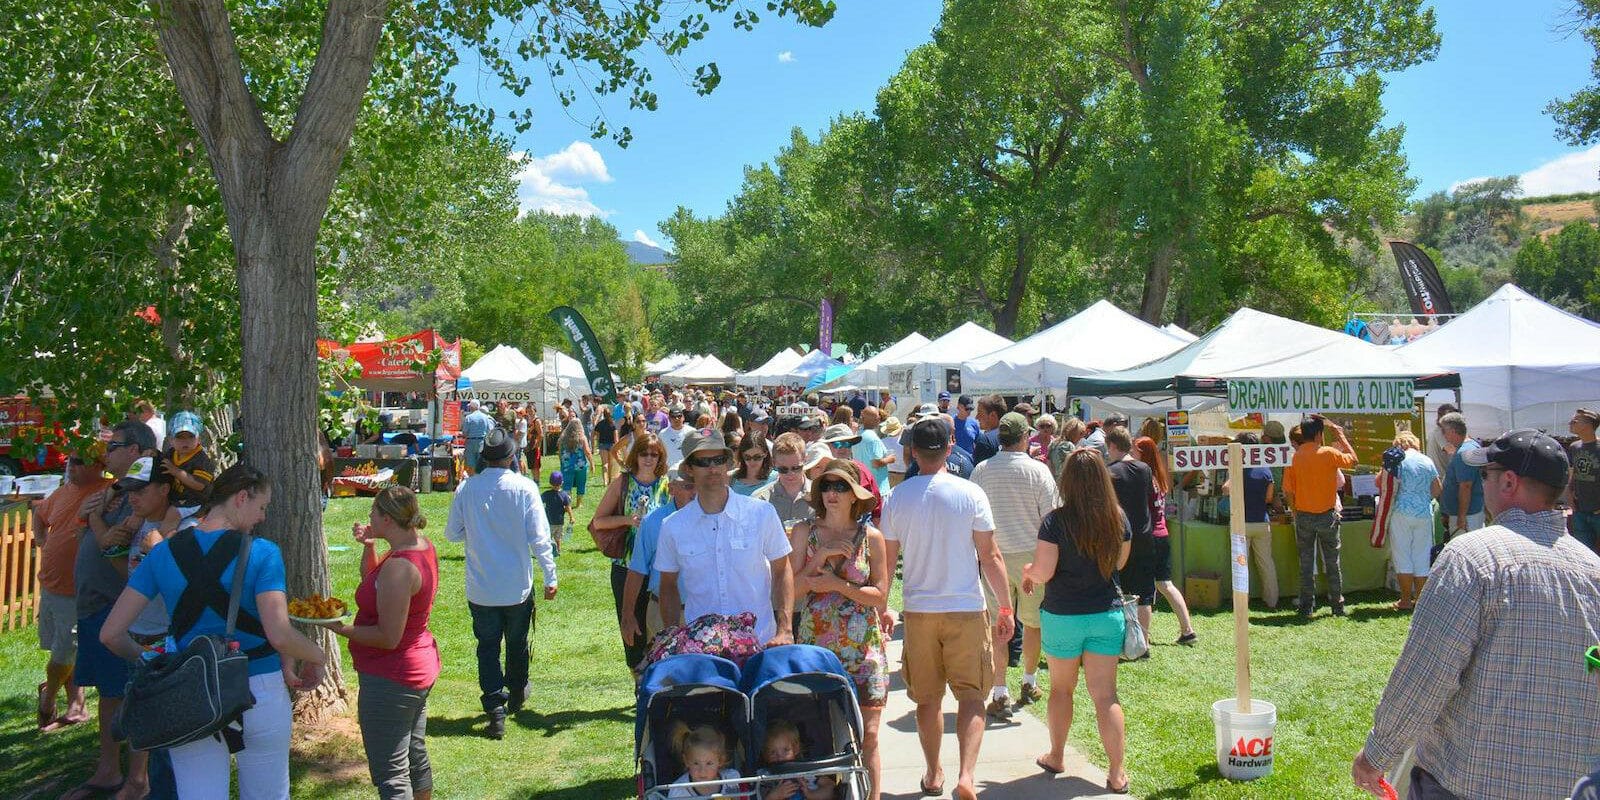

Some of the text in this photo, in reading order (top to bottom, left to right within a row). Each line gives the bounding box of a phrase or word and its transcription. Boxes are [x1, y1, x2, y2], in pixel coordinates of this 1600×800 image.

[563, 315, 599, 372] Alpine Bank
[493, 391, 530, 401] TACOS
[1229, 380, 1414, 410] ORGANIC OLIVE OIL & OLIVES
[1229, 735, 1273, 757] ACE
